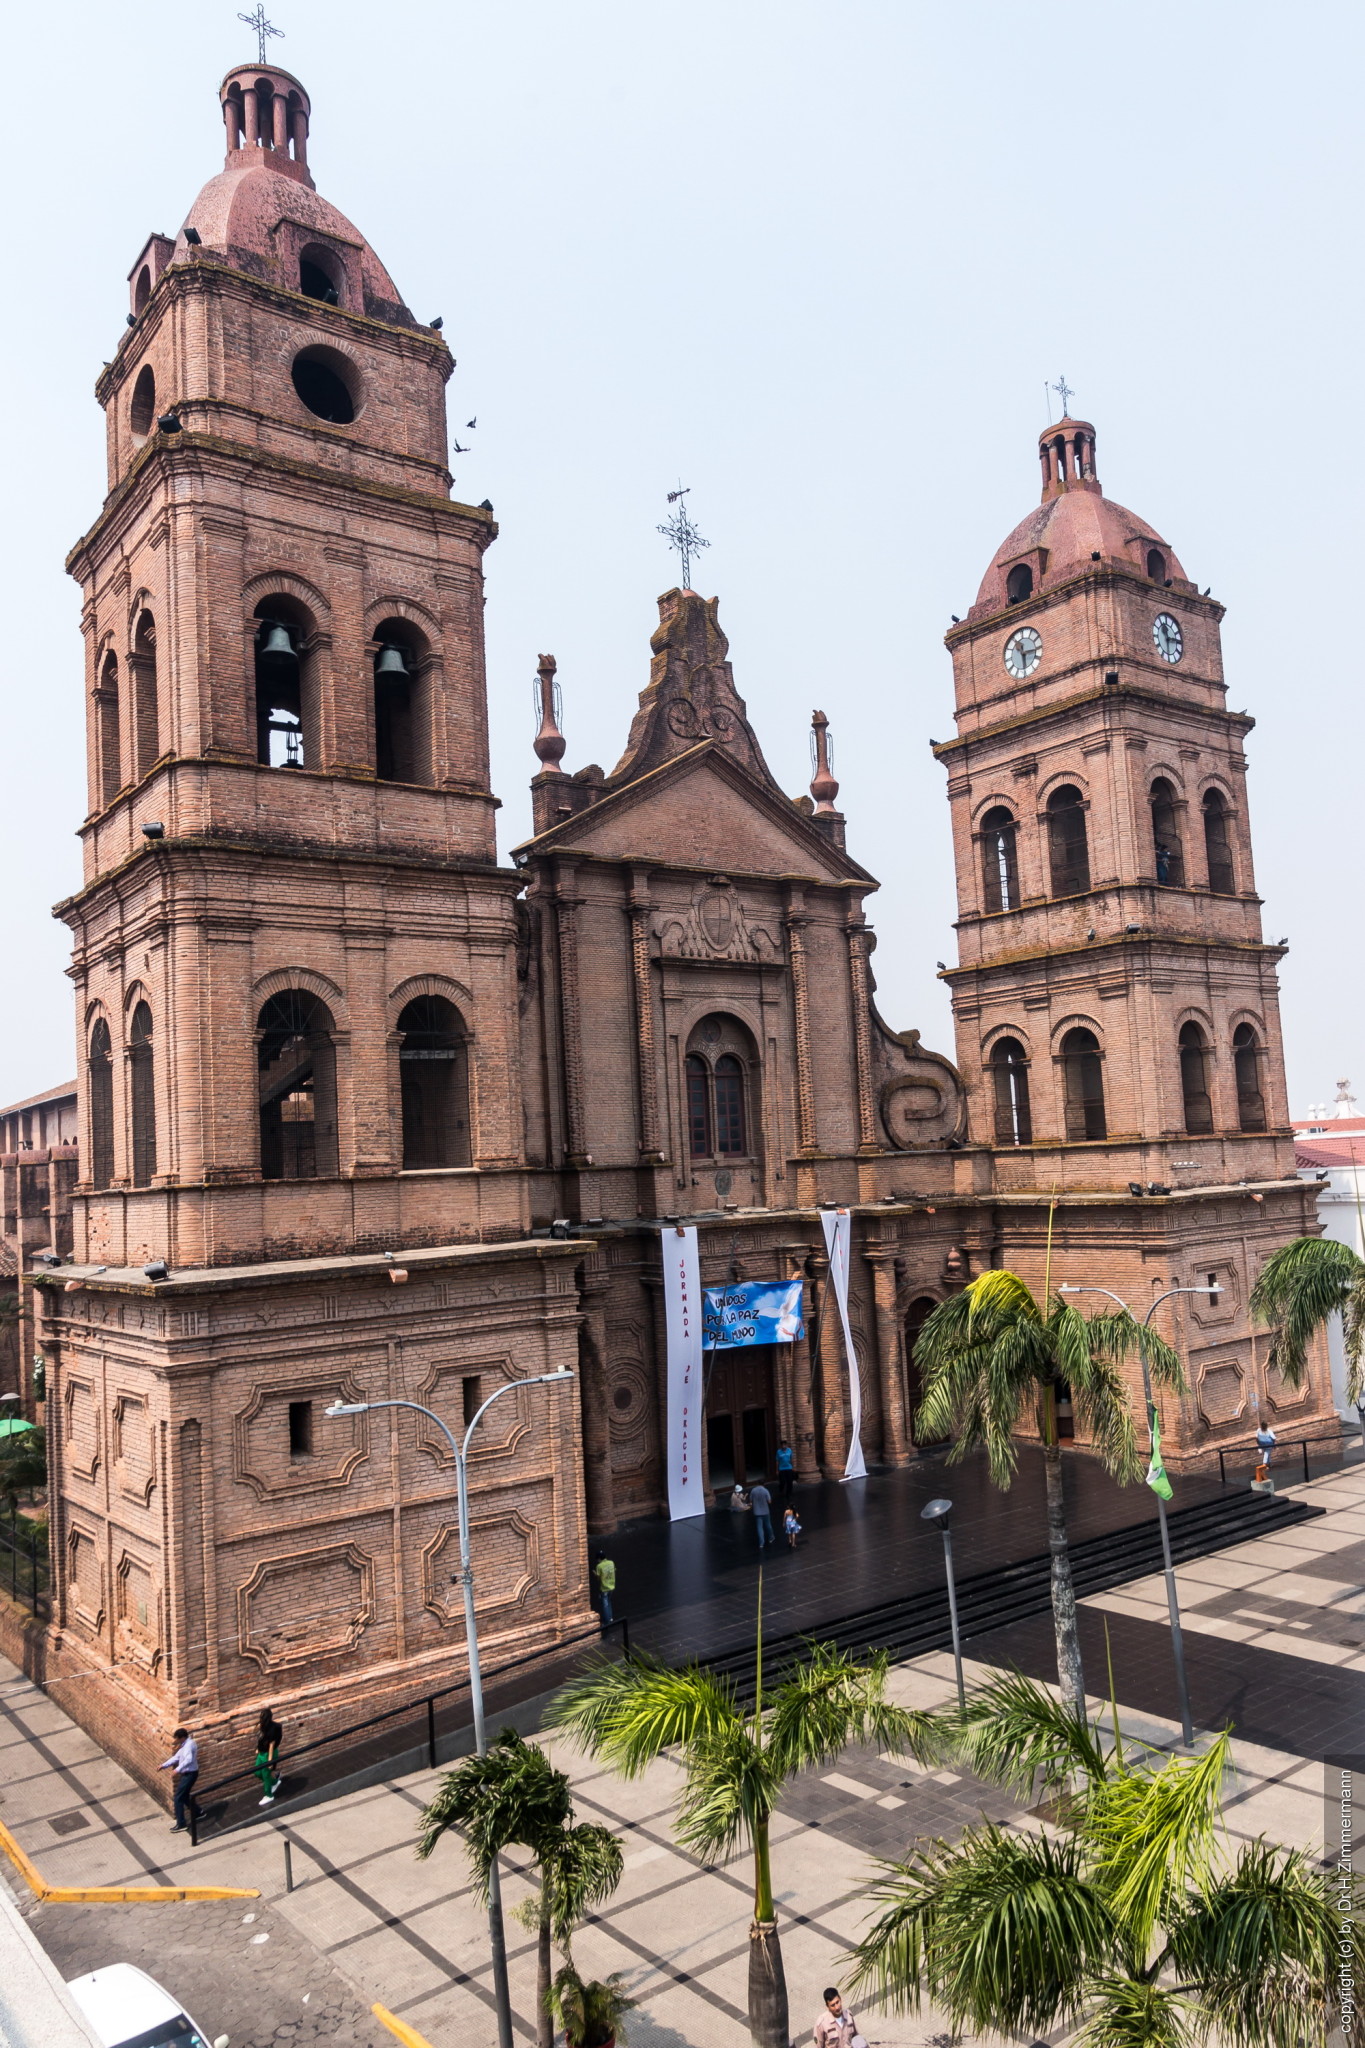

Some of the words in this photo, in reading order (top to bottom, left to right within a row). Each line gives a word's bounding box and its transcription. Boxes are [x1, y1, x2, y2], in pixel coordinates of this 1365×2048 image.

[679, 1259, 689, 1338] JORNADA
[715, 1294, 747, 1309] UNIDOS
[726, 1312, 736, 1324] LA
[738, 1310, 760, 1321] PAZ
[709, 1331, 729, 1342] DEL
[731, 1326, 755, 1341] MUNDO
